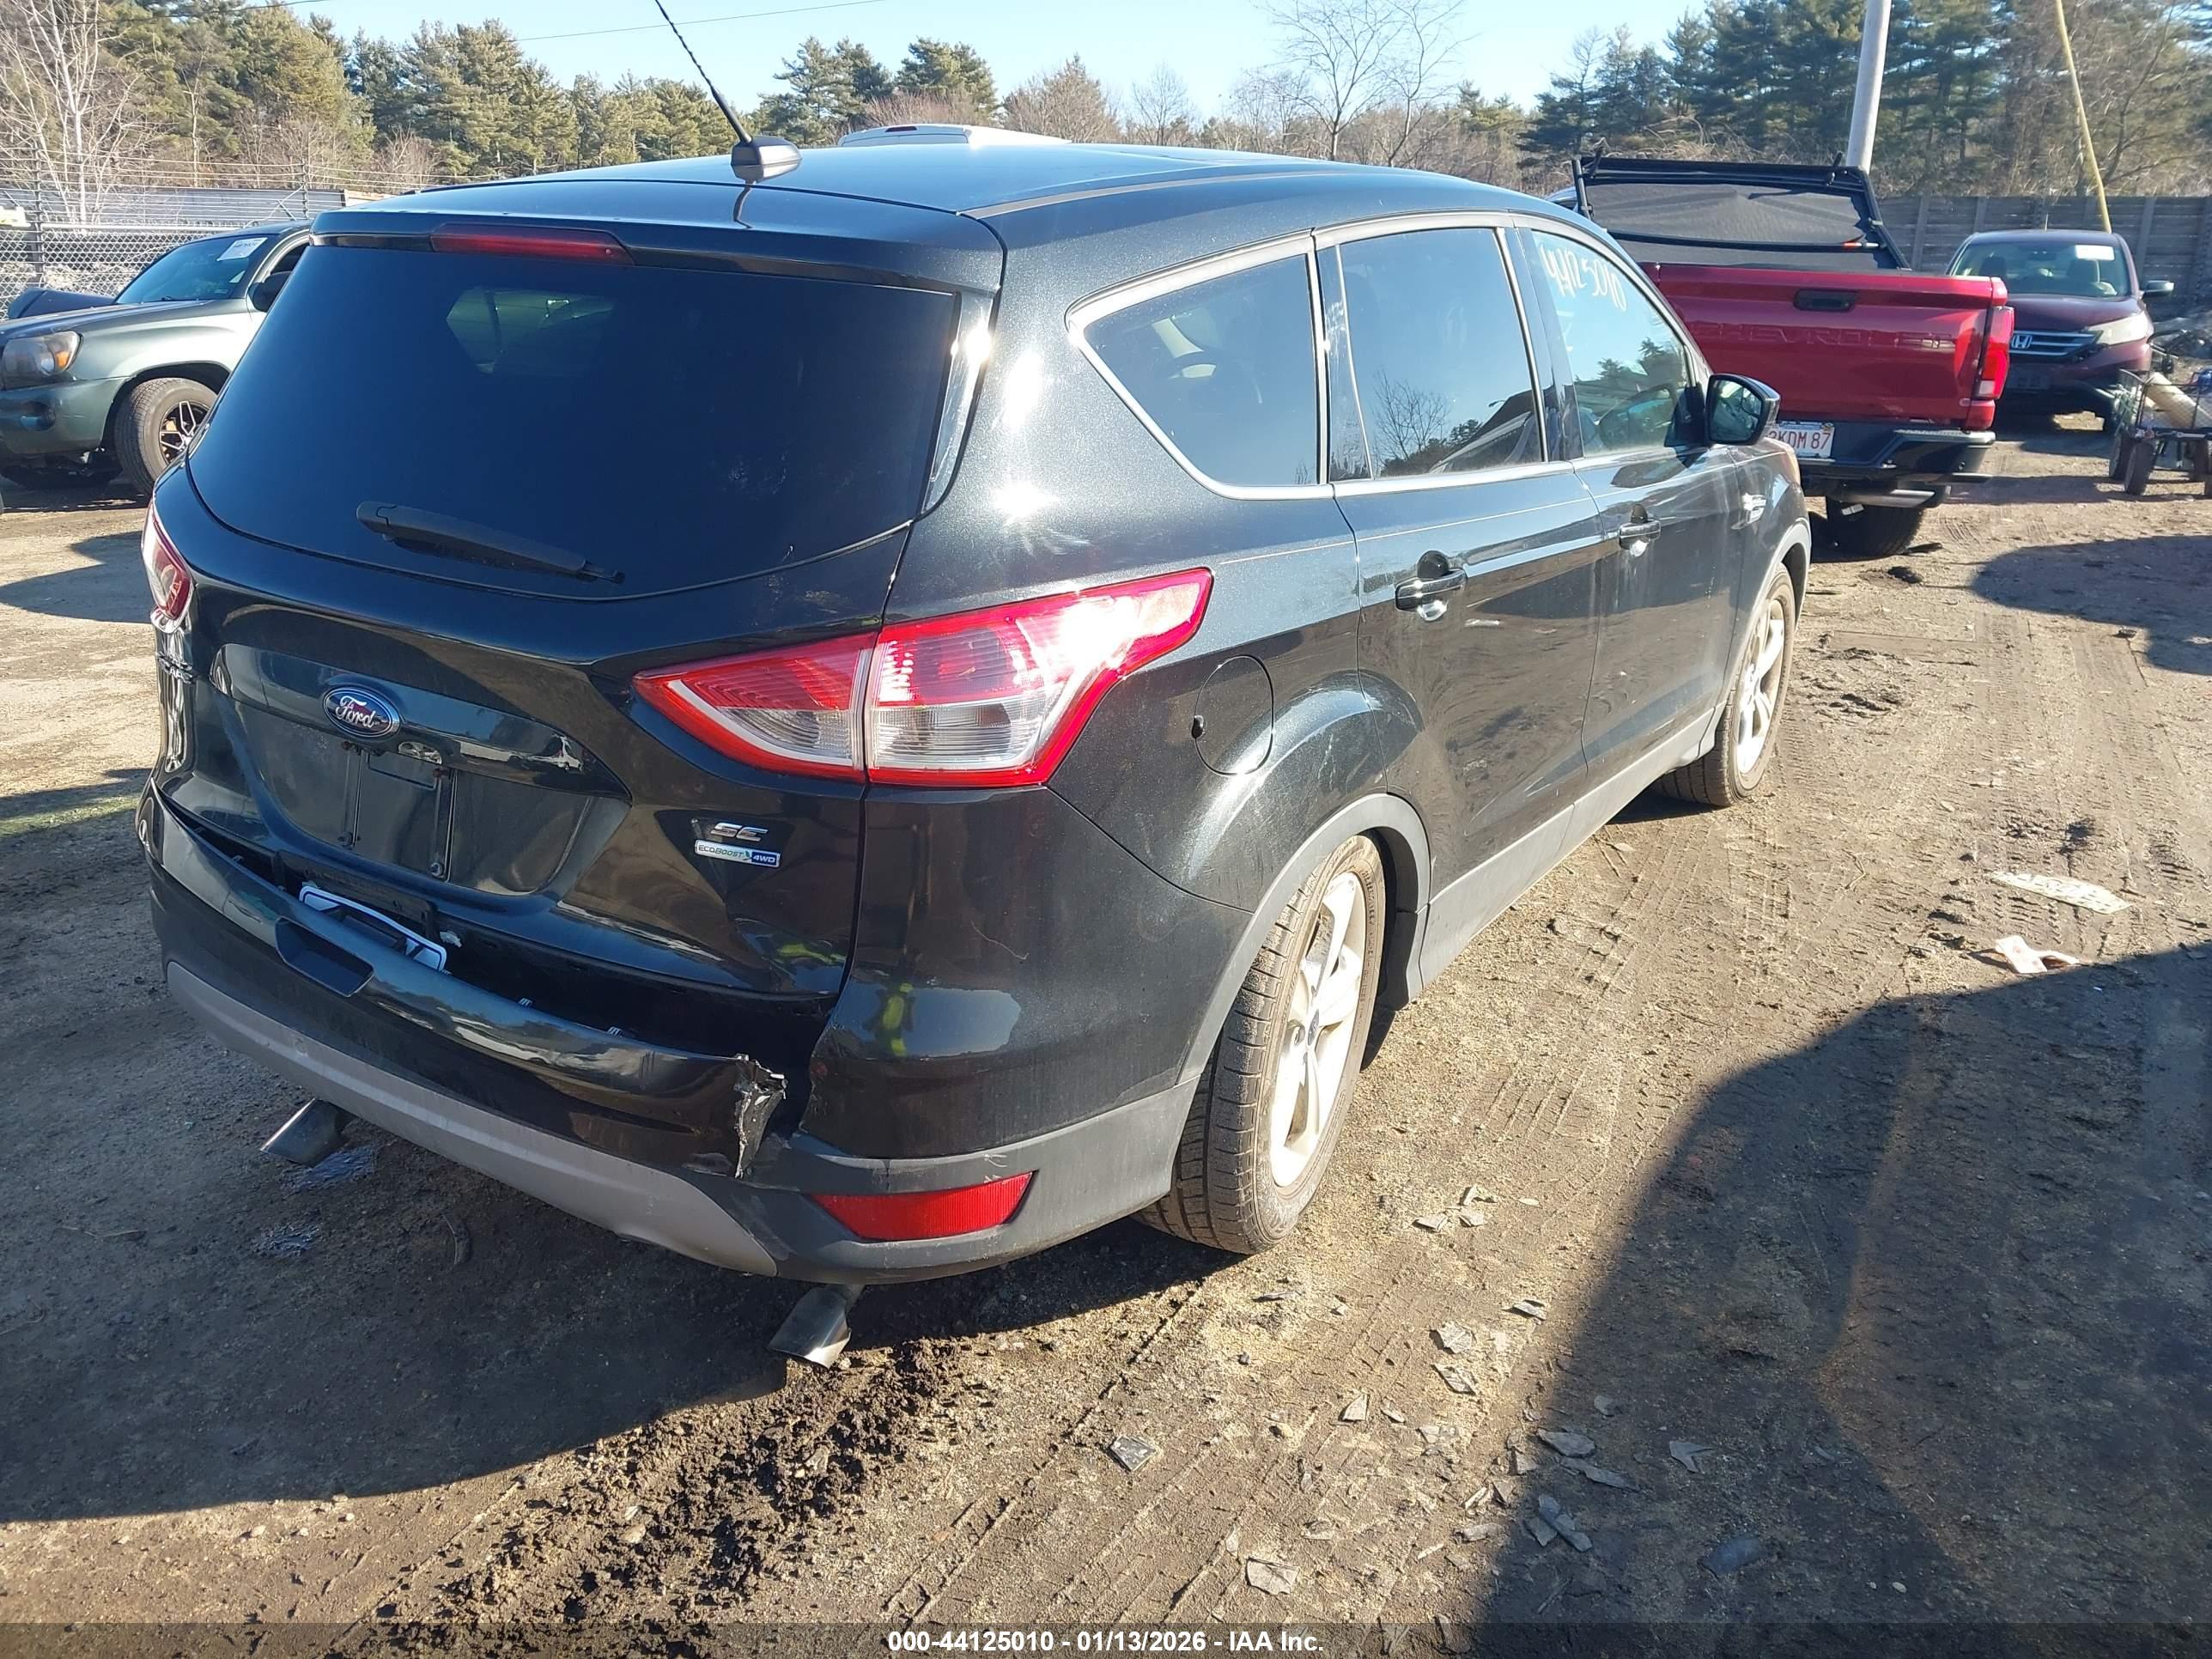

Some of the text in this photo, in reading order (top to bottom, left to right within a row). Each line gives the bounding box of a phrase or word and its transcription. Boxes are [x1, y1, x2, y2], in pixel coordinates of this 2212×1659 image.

[1690, 319, 1954, 351] CHEVROLET
[1811, 432, 1831, 449] 87
[336, 696, 376, 728] Ford
[710, 822, 769, 842] SE
[753, 854, 776, 864] 4WD
